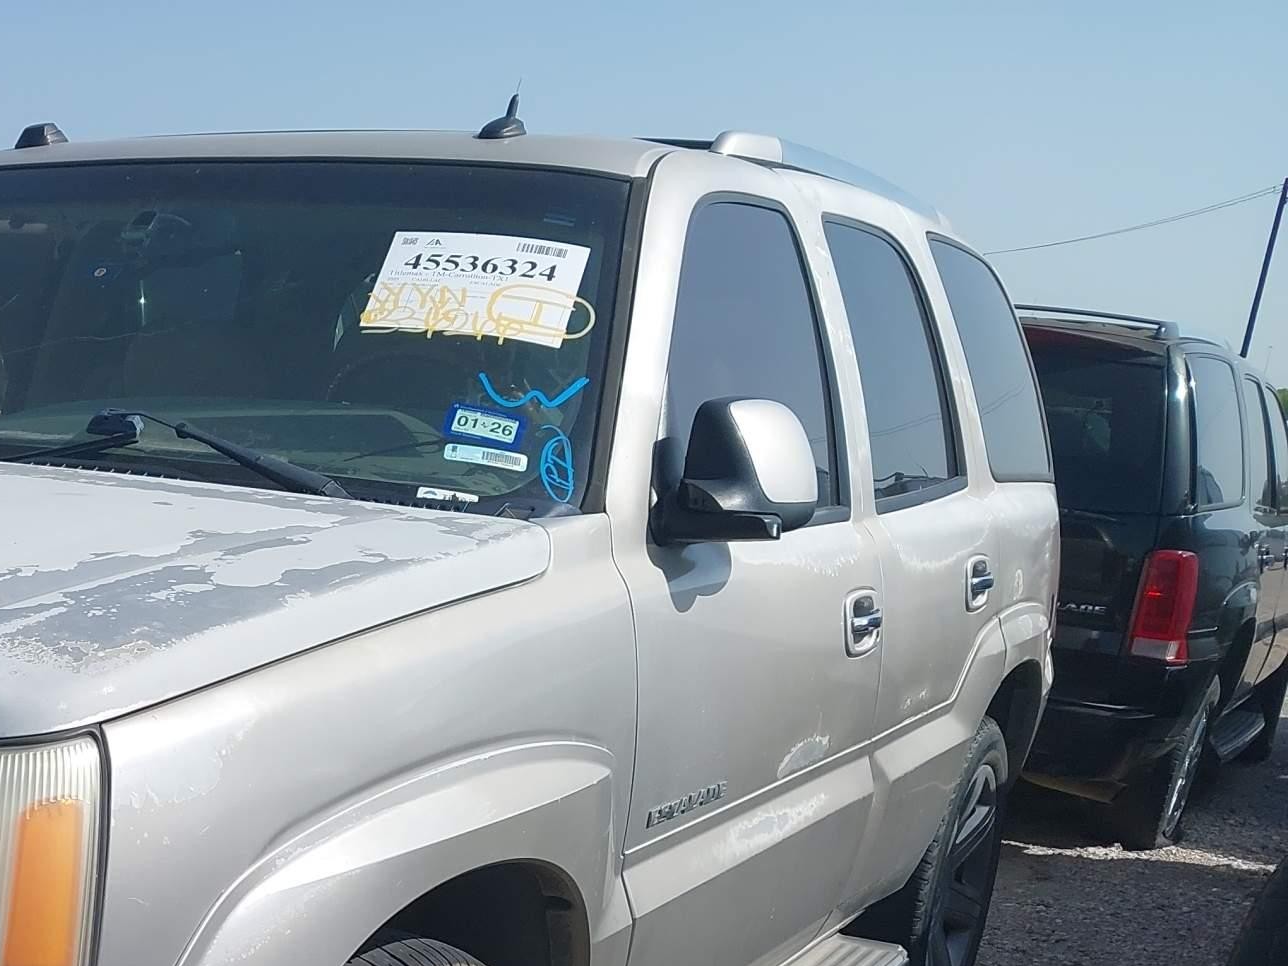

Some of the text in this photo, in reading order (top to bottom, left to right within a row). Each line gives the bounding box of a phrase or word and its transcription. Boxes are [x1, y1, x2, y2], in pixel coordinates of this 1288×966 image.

[404, 253, 557, 281] 45536324
[456, 415, 479, 429] 01
[489, 421, 514, 437] 26
[646, 780, 728, 829] ESCALADE
